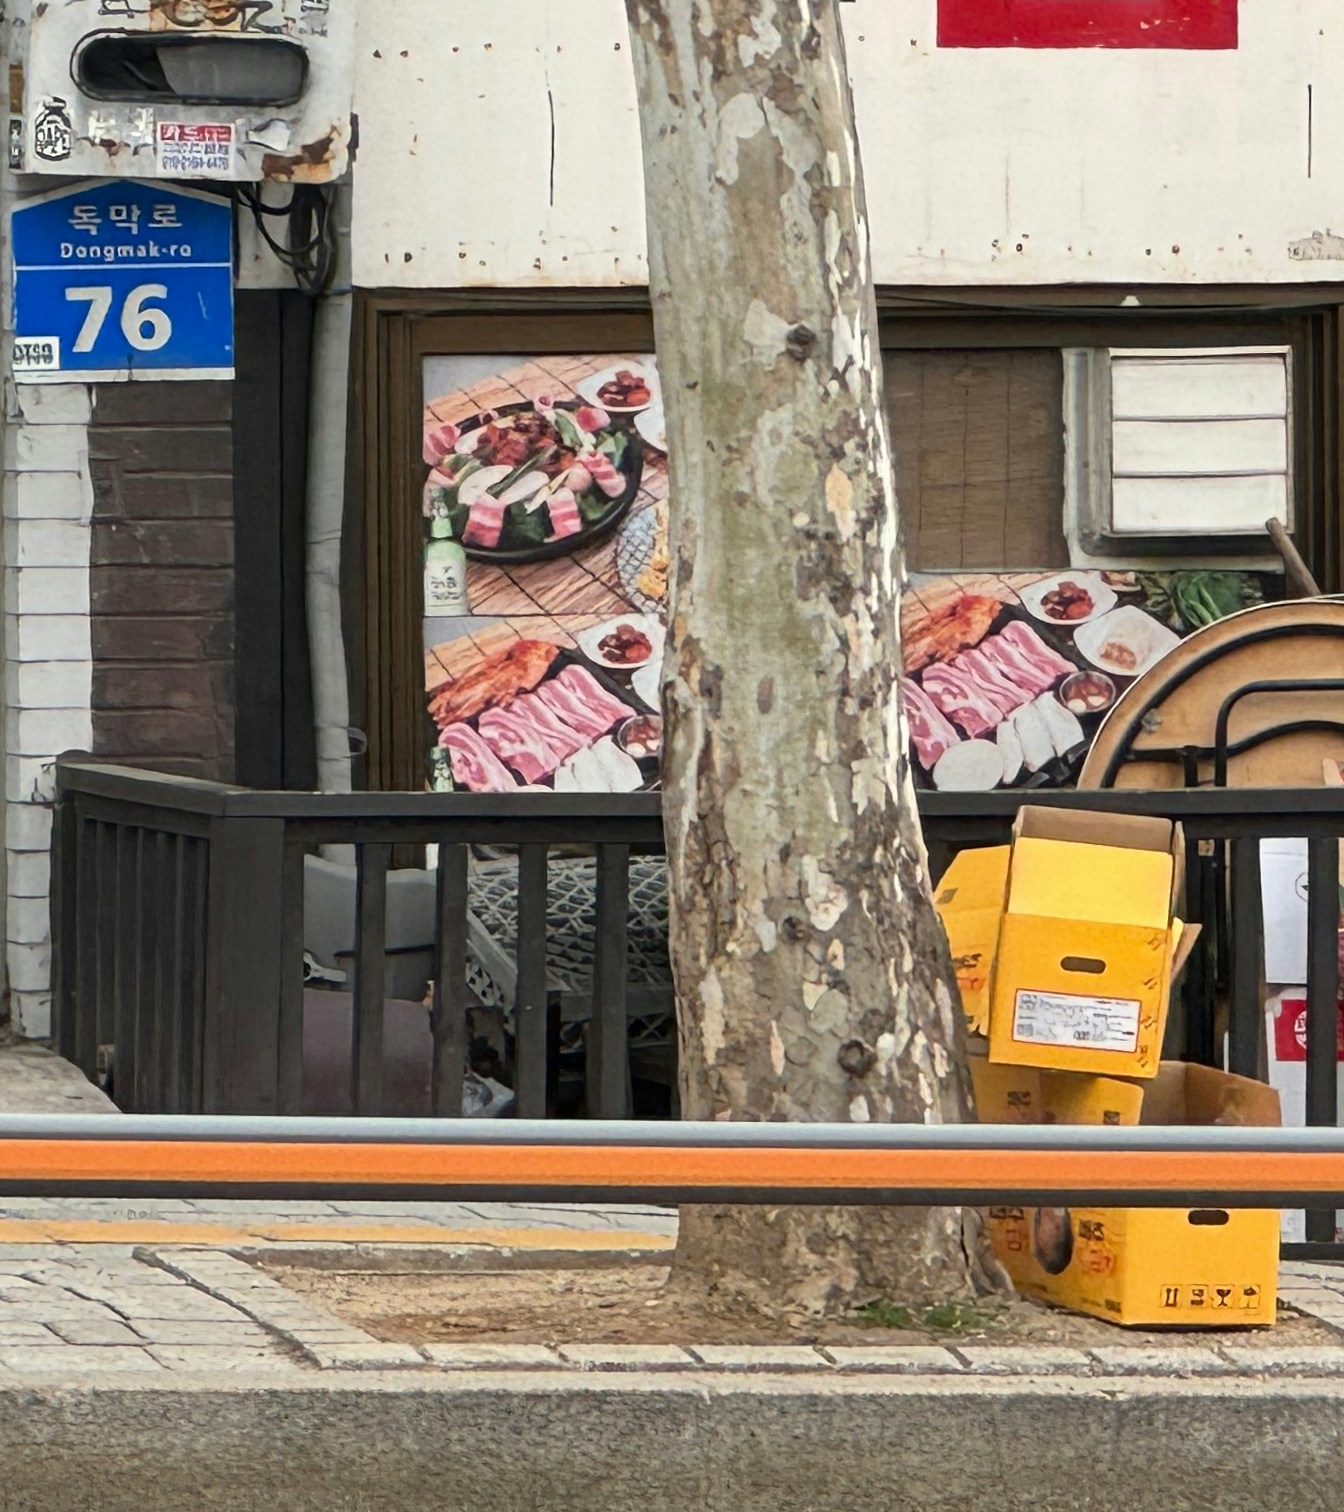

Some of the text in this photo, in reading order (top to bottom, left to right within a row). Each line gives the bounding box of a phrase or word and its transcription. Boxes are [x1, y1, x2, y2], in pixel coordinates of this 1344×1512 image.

[67, 204, 183, 236] 독막로
[60, 242, 192, 262] Dongmak-ro
[64, 283, 173, 353] 76
